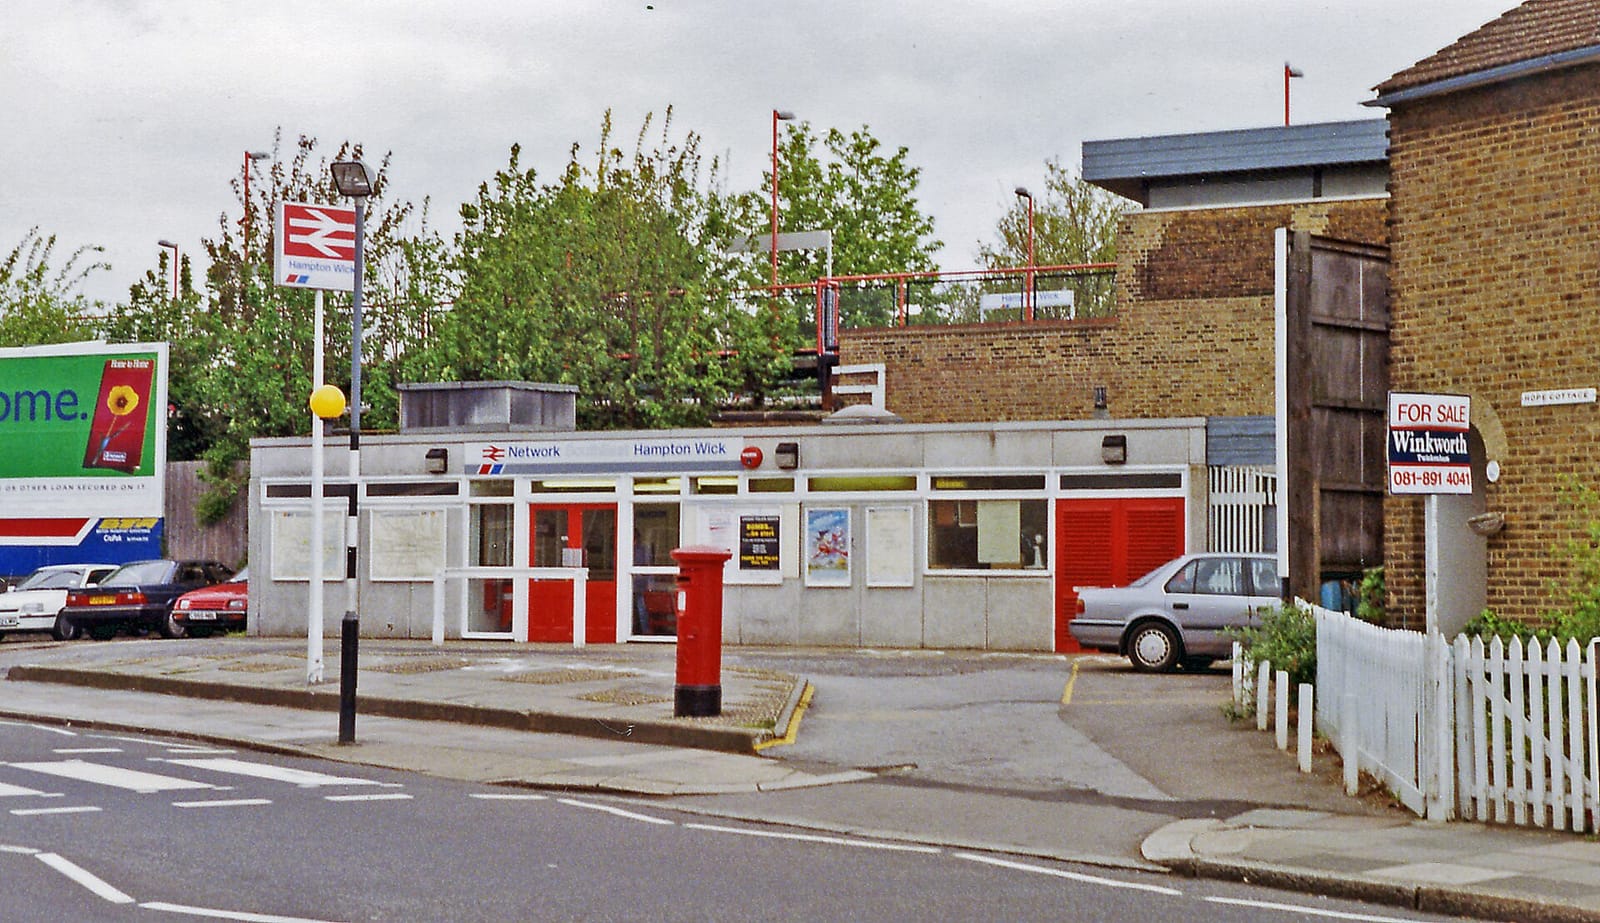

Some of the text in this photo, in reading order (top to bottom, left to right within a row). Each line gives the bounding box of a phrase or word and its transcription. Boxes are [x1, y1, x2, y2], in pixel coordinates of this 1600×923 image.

[289, 261, 331, 272] Hampton
[1398, 404, 1466, 423] FOR SALE
[508, 446, 560, 457] Network
[634, 443, 691, 456] Hampton
[695, 442, 726, 454] Wick
[1392, 430, 1468, 454] Winkworth
[1393, 472, 1470, 486] 081-891 4041
